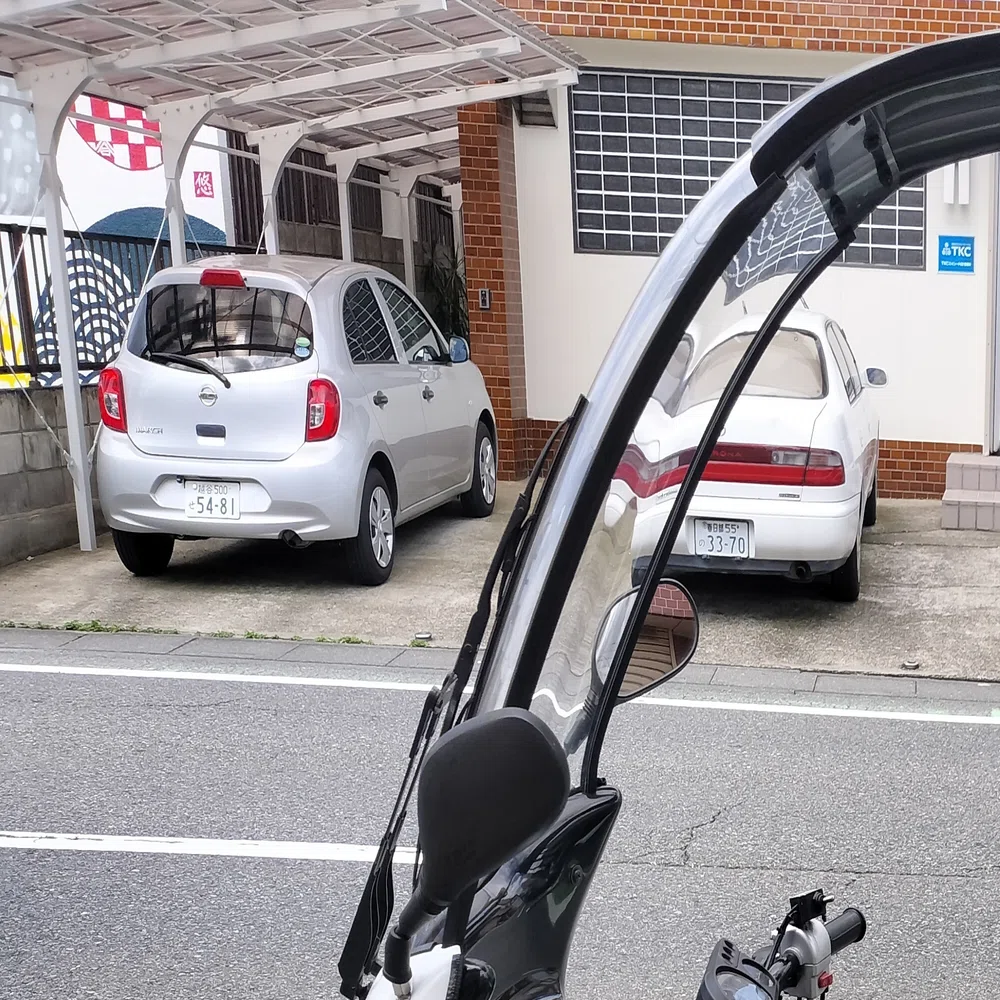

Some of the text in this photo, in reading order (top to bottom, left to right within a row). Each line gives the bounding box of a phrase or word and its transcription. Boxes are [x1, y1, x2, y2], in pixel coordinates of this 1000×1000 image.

[951, 246, 972, 257] TKC
[197, 496, 234, 516] 54-81
[707, 534, 745, 554] 33-70
